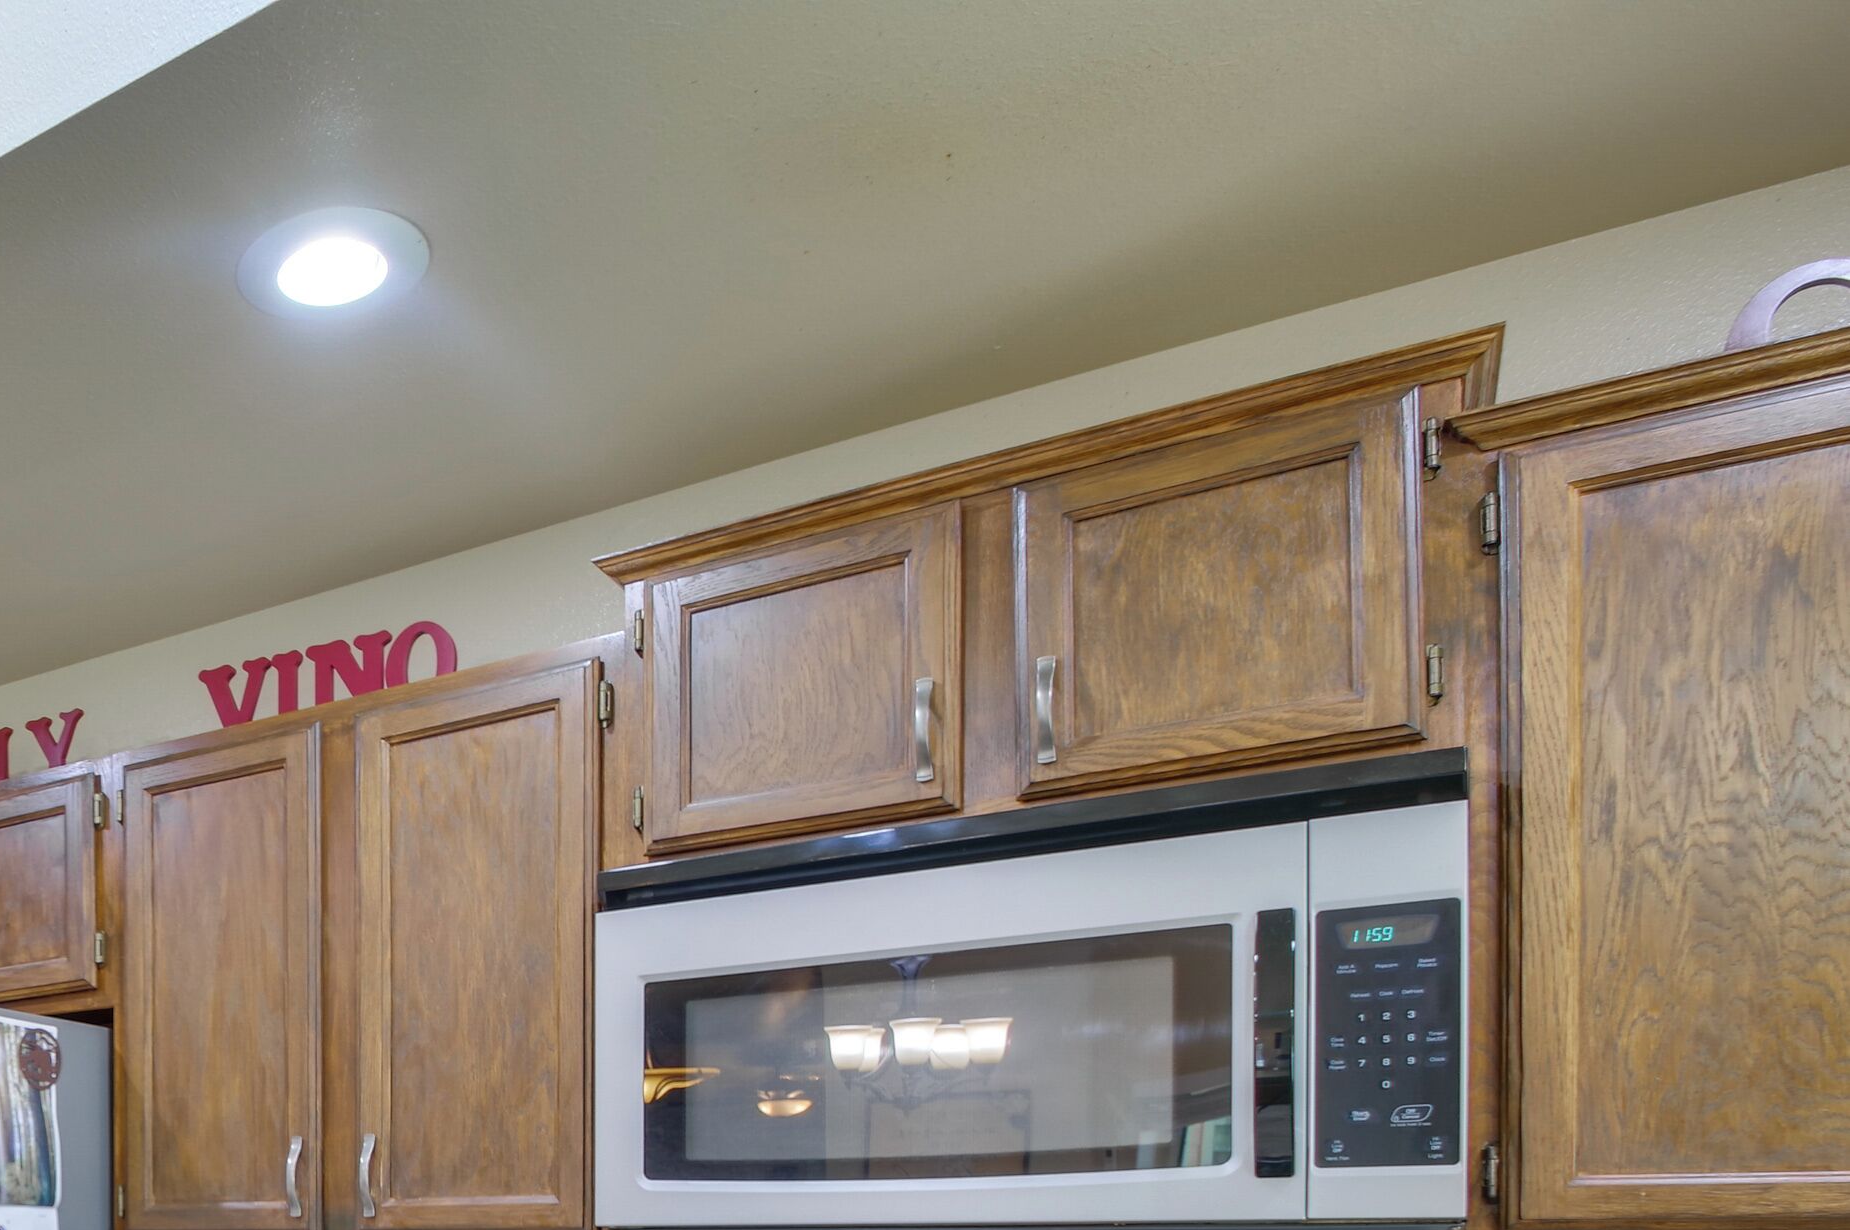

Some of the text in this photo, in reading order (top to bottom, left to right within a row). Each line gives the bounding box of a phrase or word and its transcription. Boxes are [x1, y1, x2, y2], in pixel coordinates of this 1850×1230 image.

[198, 620, 458, 728] VINO
[1382, 1012, 1391, 1020] 2
[1407, 1010, 1416, 1019] 3
[1358, 1036, 1366, 1044] 4
[1382, 1035, 1390, 1043] 5
[1407, 1033, 1415, 1042] 6
[1358, 1059, 1366, 1067] 7
[1382, 1058, 1390, 1066] 8
[1407, 1056, 1415, 1065] 9
